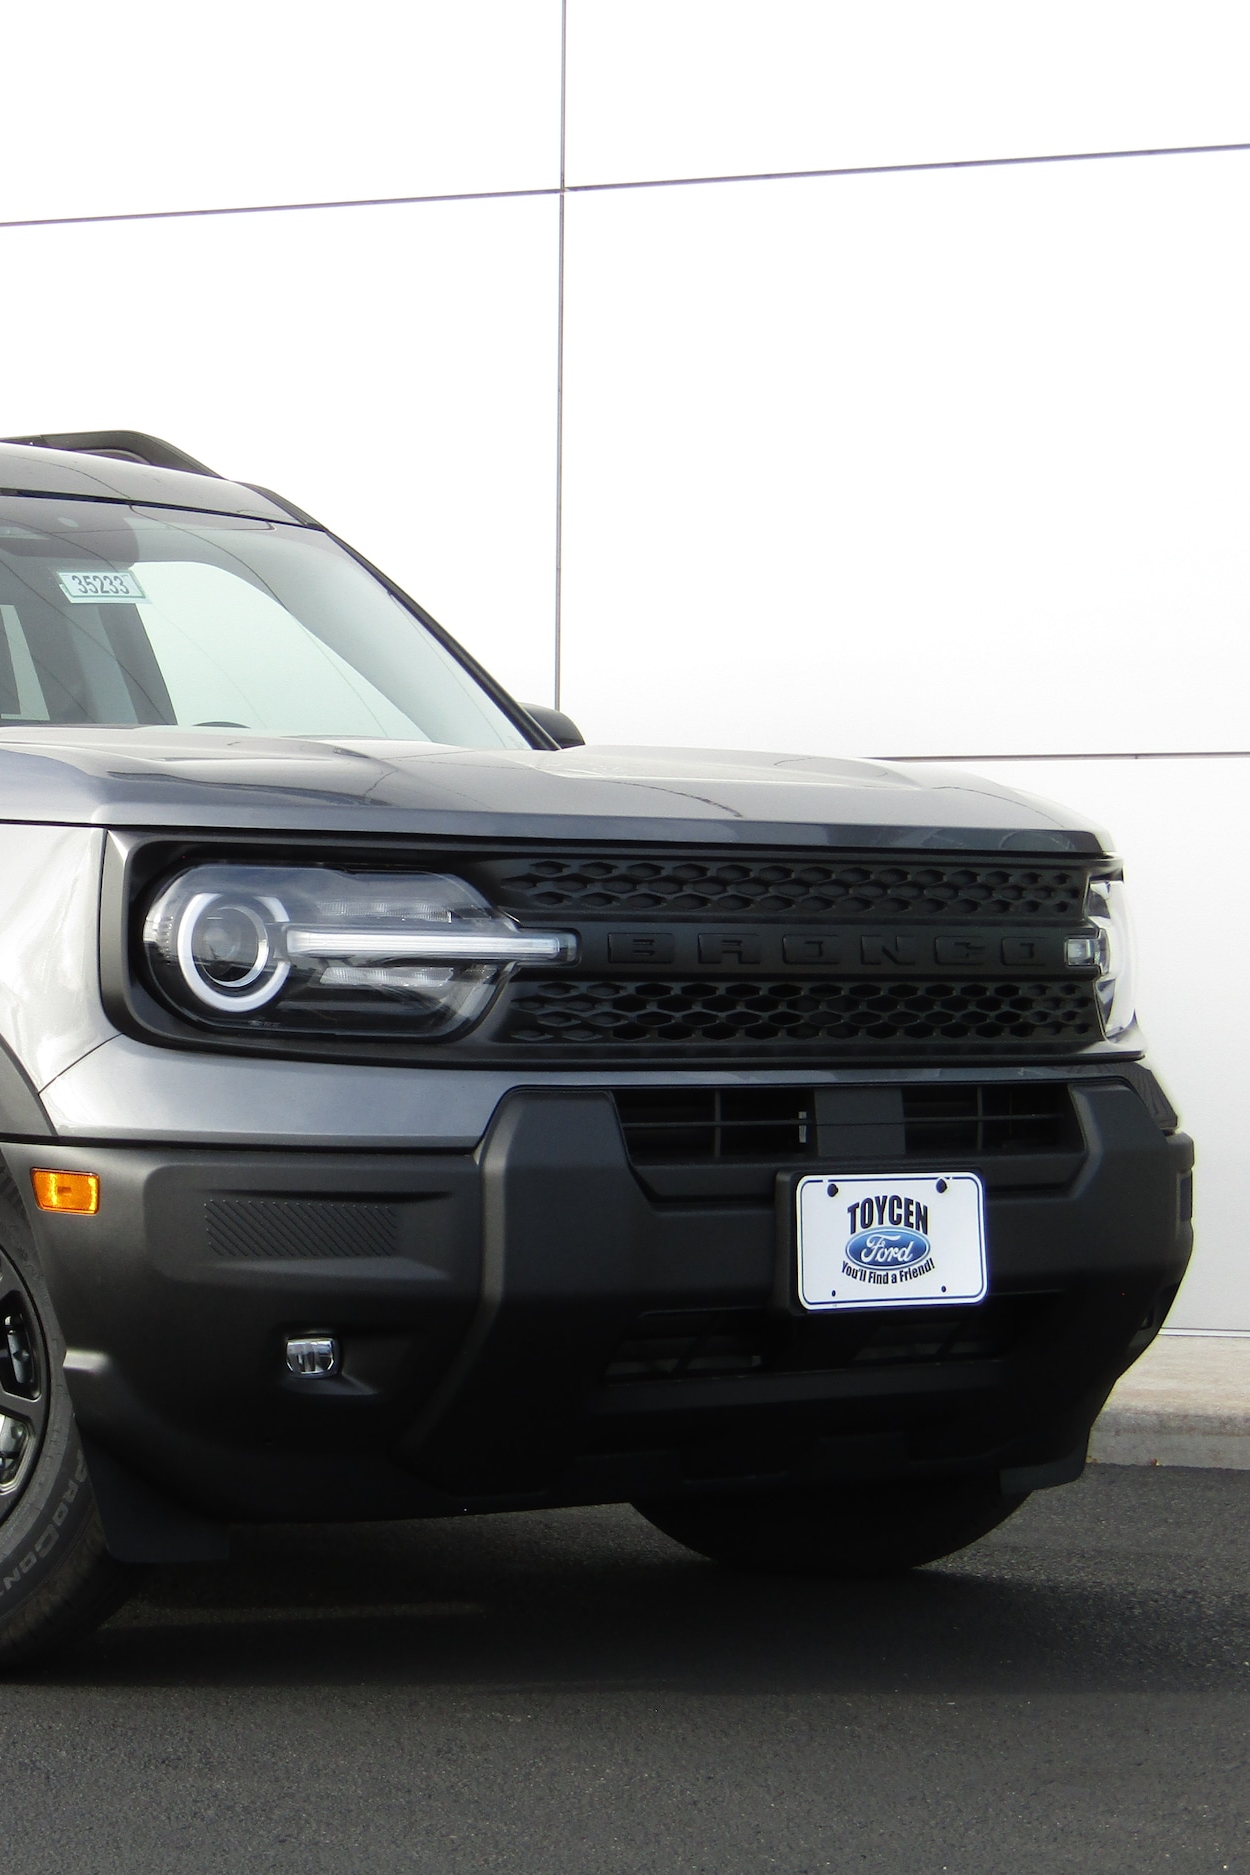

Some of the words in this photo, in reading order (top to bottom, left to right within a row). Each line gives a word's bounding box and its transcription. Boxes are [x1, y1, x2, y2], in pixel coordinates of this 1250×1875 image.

[71, 575, 130, 594] 35233
[607, 932, 1048, 966] BRONCO
[847, 1195, 928, 1235] TOYCEN
[861, 1233, 914, 1263] Ford
[841, 1260, 866, 1283] You'll
[868, 1271, 889, 1285] Find
[891, 1274, 898, 1284] a
[899, 1257, 935, 1283] Friend!
